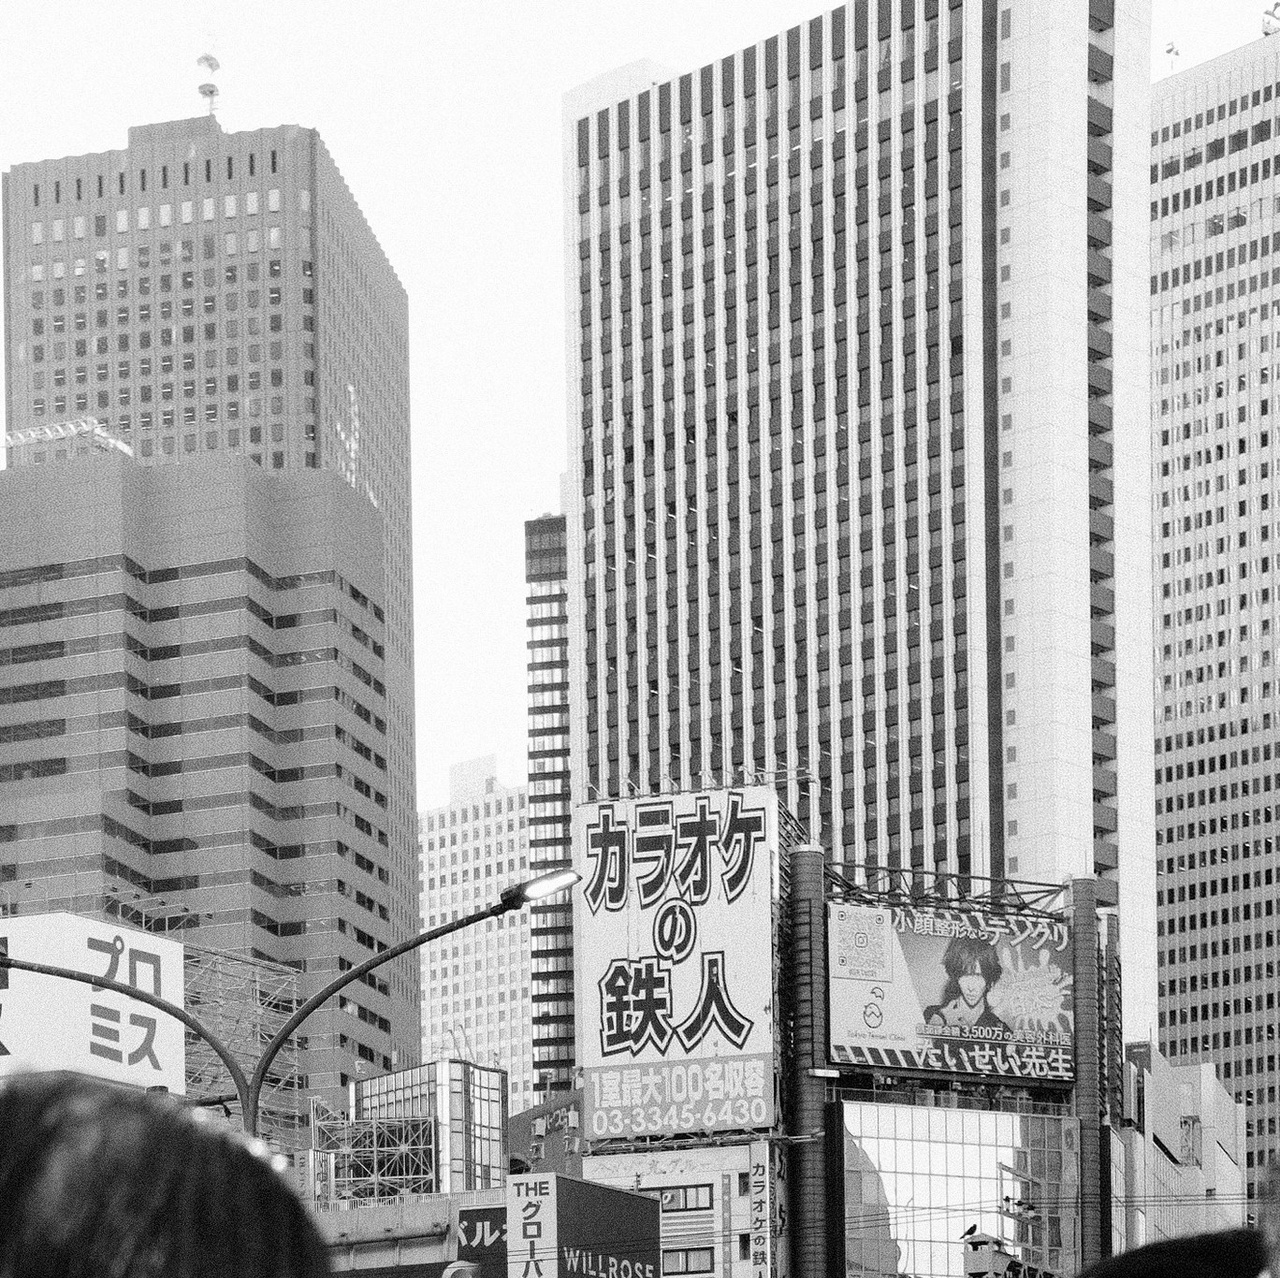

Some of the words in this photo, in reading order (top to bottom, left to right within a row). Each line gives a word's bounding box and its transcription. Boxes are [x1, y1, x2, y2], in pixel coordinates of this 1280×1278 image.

[583, 792, 767, 916] カラオケ
[652, 897, 697, 966] の
[87, 935, 161, 998] プロ
[90, 1003, 162, 1070] ミス
[597, 951, 754, 1058] 鉄人
[591, 1060, 766, 1109] 1室最大100名収容
[592, 1099, 768, 1137] 03-3345-6430
[512, 1180, 550, 1198] THE
